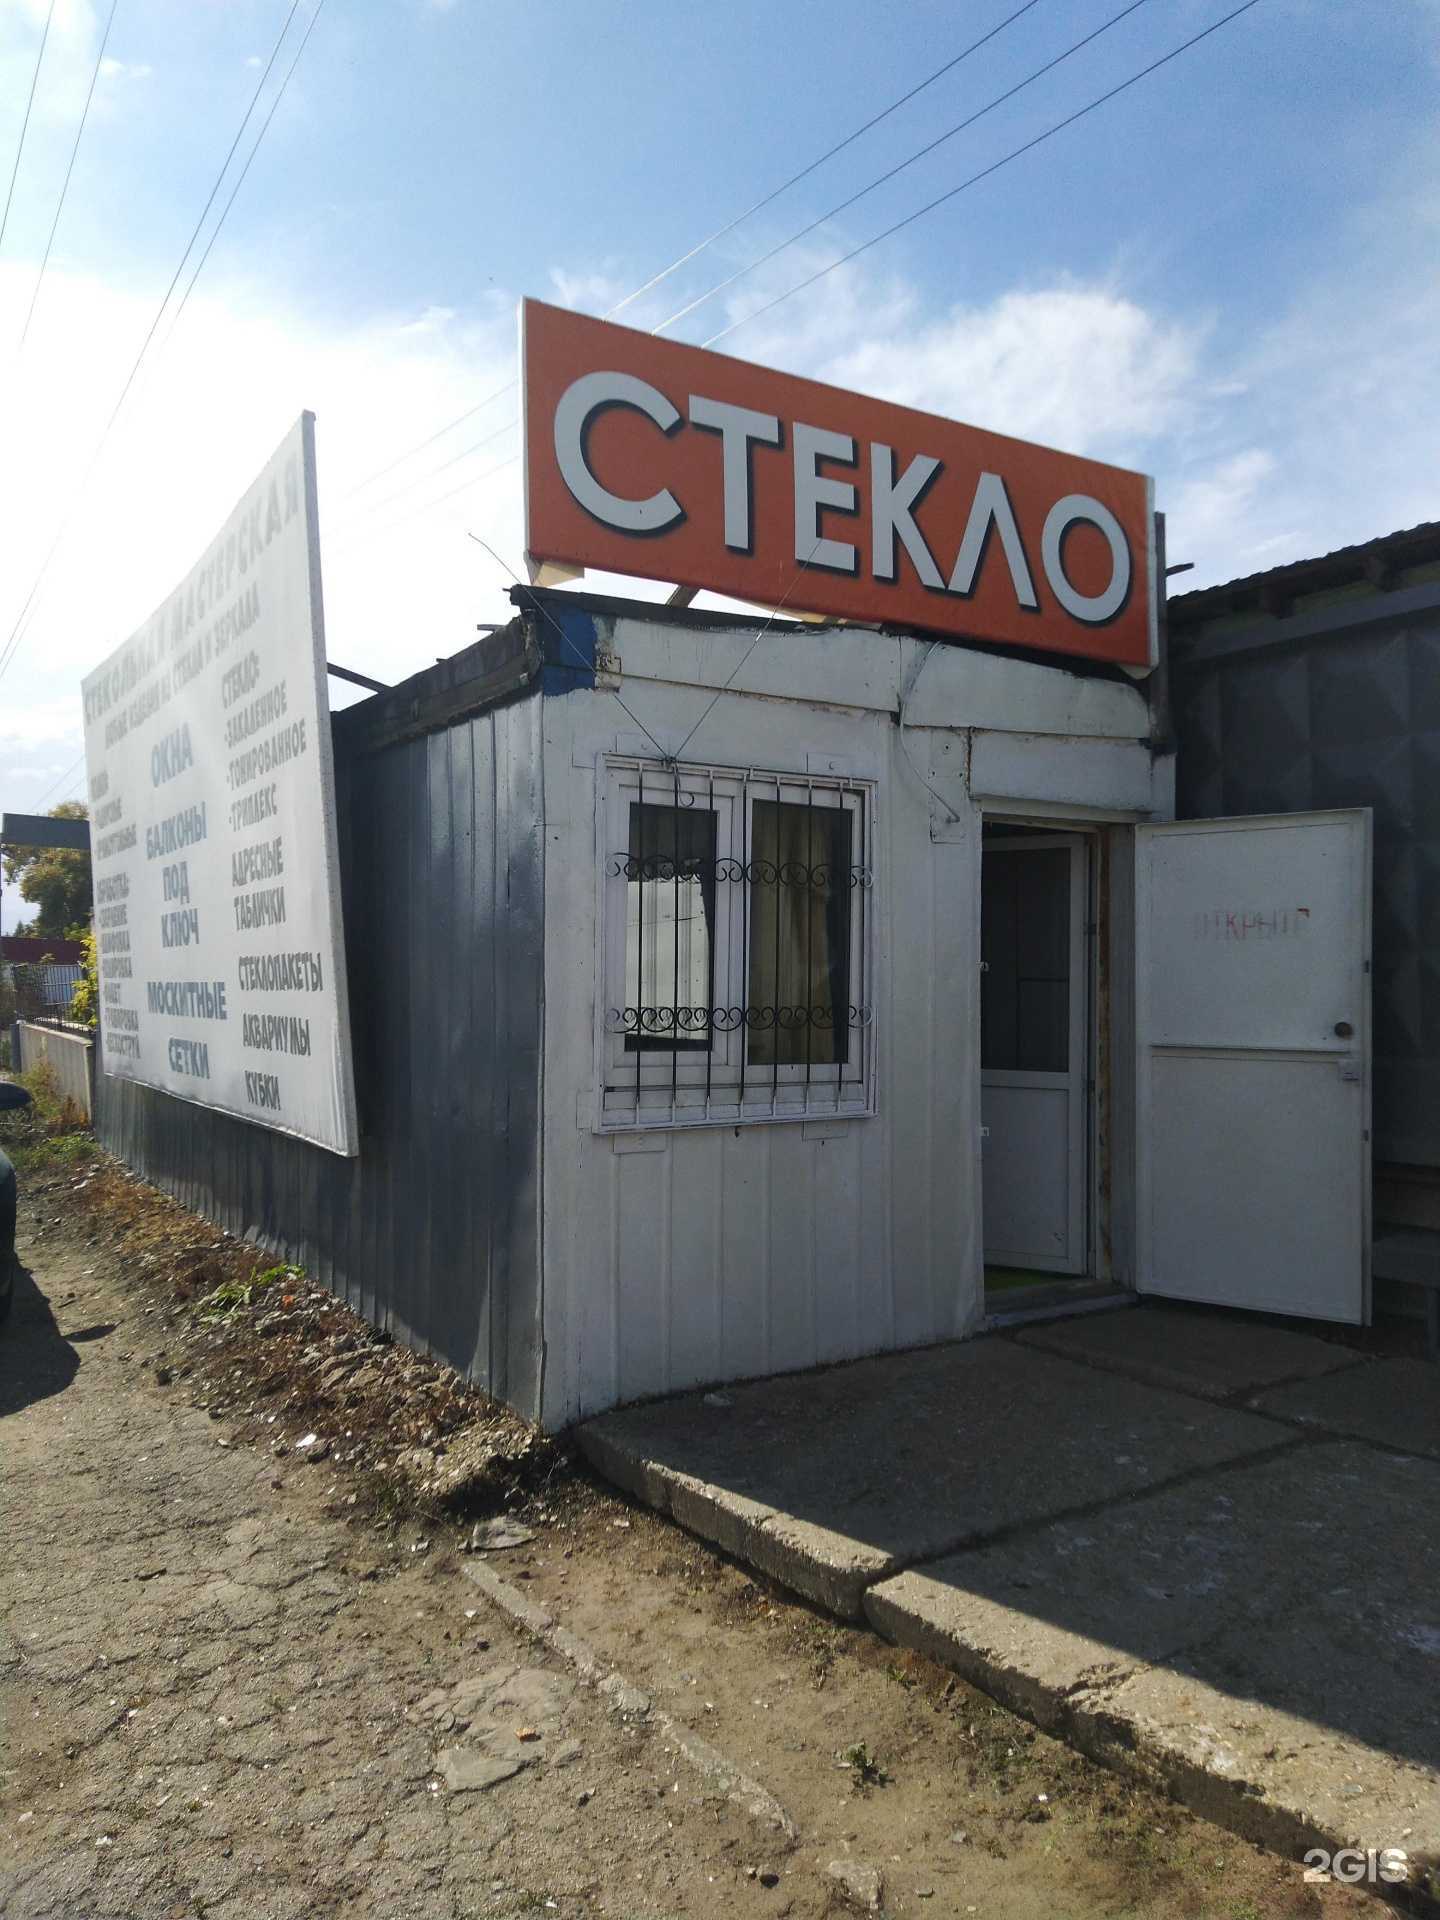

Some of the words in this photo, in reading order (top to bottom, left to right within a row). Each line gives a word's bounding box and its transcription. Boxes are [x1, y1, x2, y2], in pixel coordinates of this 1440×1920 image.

[554, 371, 1131, 622] СТЕКЛО
[168, 455, 299, 648] МАСТЕРСКАЯ
[172, 637, 203, 694] СТЕКЛА
[213, 578, 259, 658] ЗЕРКАЛА
[150, 719, 193, 790] ОКНА
[145, 801, 207, 861] БАЛКОНЫ
[162, 860, 189, 905] ПОД
[231, 836, 283, 886] АДРЕСНЫЕ
[161, 908, 199, 947] КЛЮЧ
[233, 885, 286, 930] ТАБЛИЧКИ
[237, 951, 323, 991] СТЕКЛОПАКЕТЫ
[147, 981, 227, 1019] МОСКИТНЫЕ
[241, 1013, 311, 1056] АКВАРИУМЫ
[167, 1037, 209, 1079] СЕТКИ
[244, 1069, 281, 1111] КУБКИ
